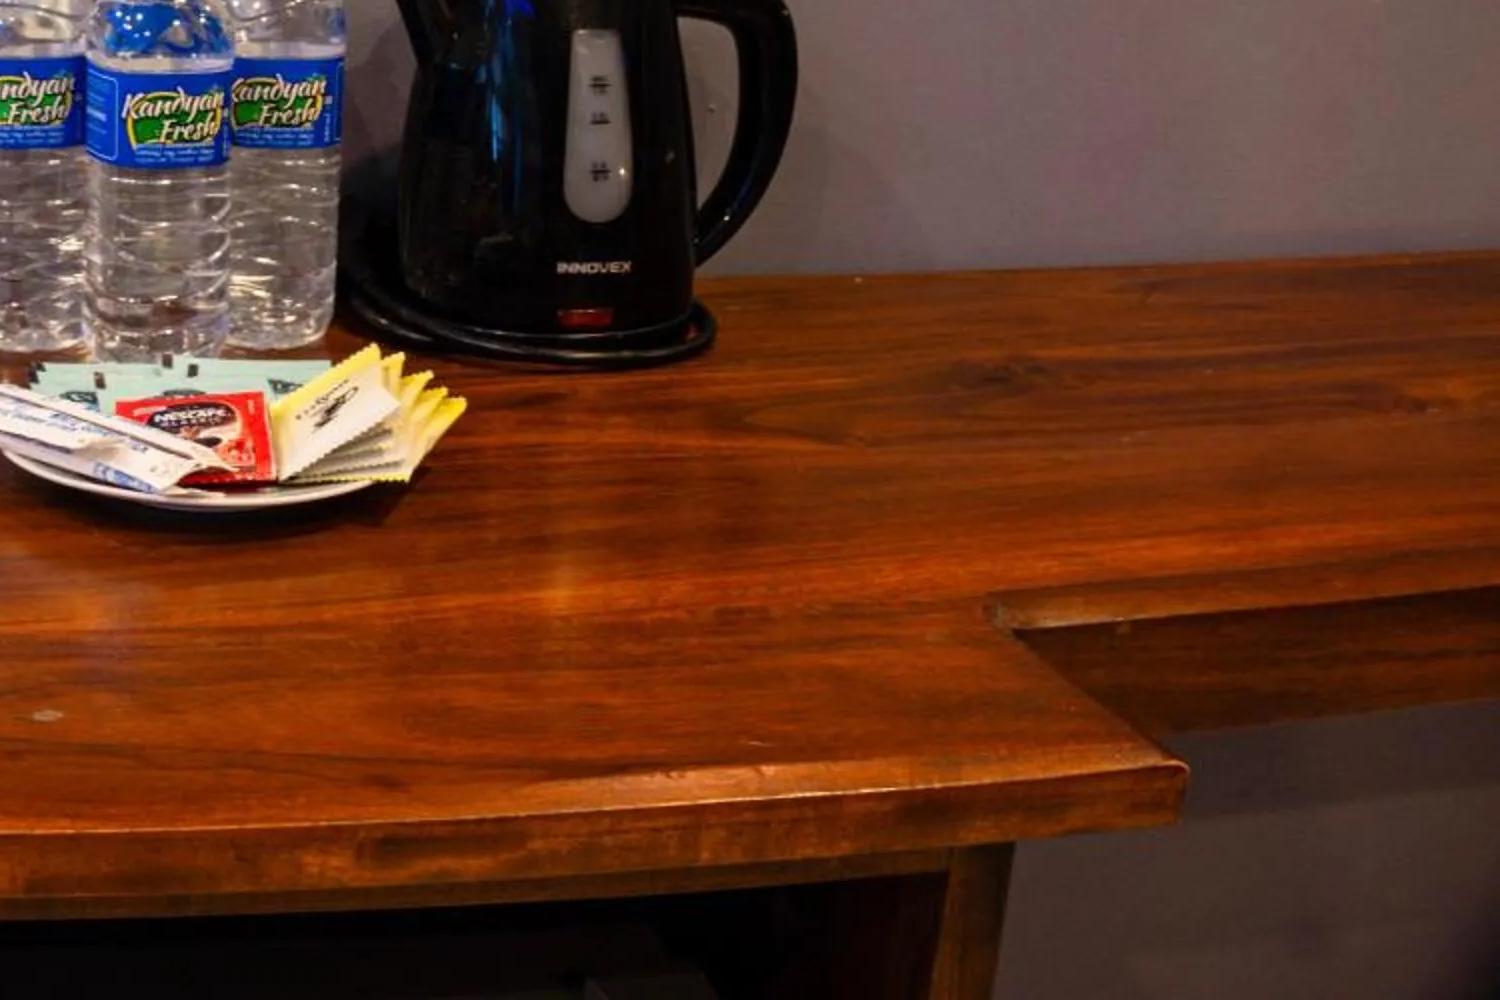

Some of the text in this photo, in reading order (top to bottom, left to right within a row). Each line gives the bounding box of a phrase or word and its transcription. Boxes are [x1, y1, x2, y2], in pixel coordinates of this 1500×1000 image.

[6, 96, 71, 125] Fresh
[121, 85, 225, 124] Kandyan
[259, 98, 320, 126] Fresh
[160, 111, 218, 143] Fresh
[557, 261, 632, 274] INNOVEX
